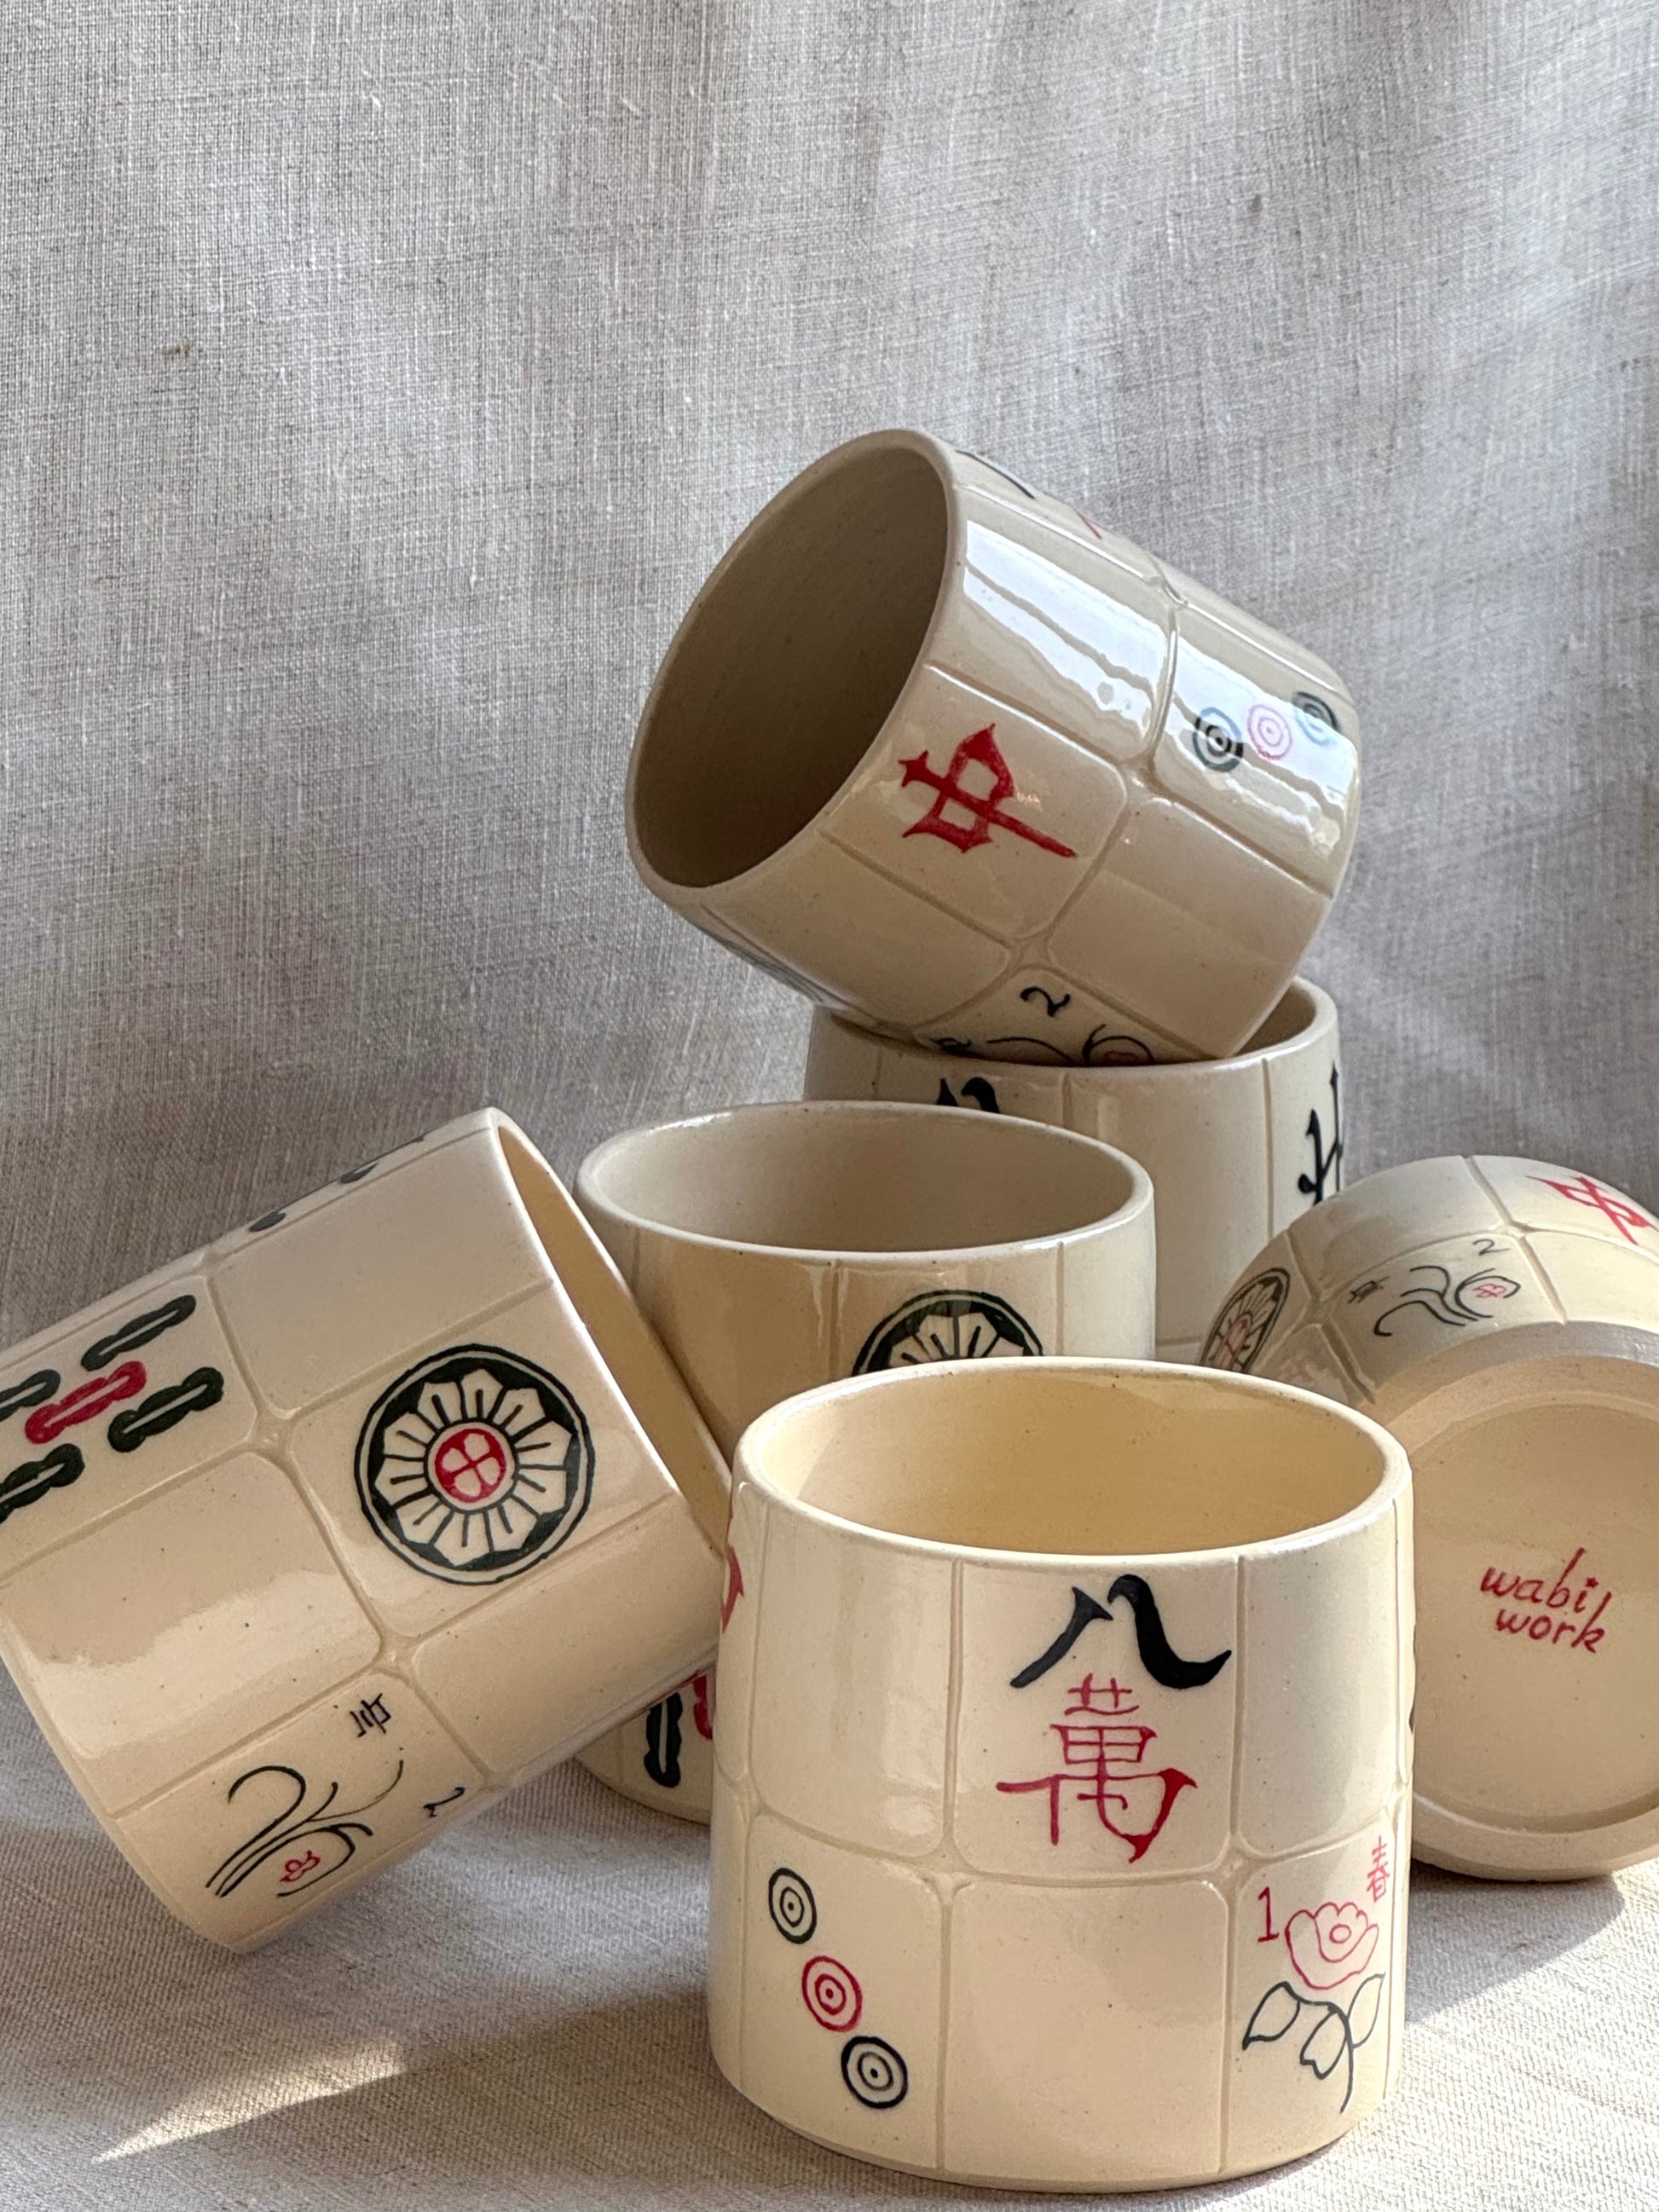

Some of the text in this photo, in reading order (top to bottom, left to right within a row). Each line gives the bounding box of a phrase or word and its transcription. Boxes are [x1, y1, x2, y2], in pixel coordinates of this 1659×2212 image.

[898, 723, 1078, 858] 中
[1020, 985, 1071, 1018] 2
[1472, 1239, 1512, 1256] 2
[1480, 1547, 1599, 1614] wabi
[1495, 1591, 1613, 1655] work
[1257, 1886, 1280, 1943] 1
